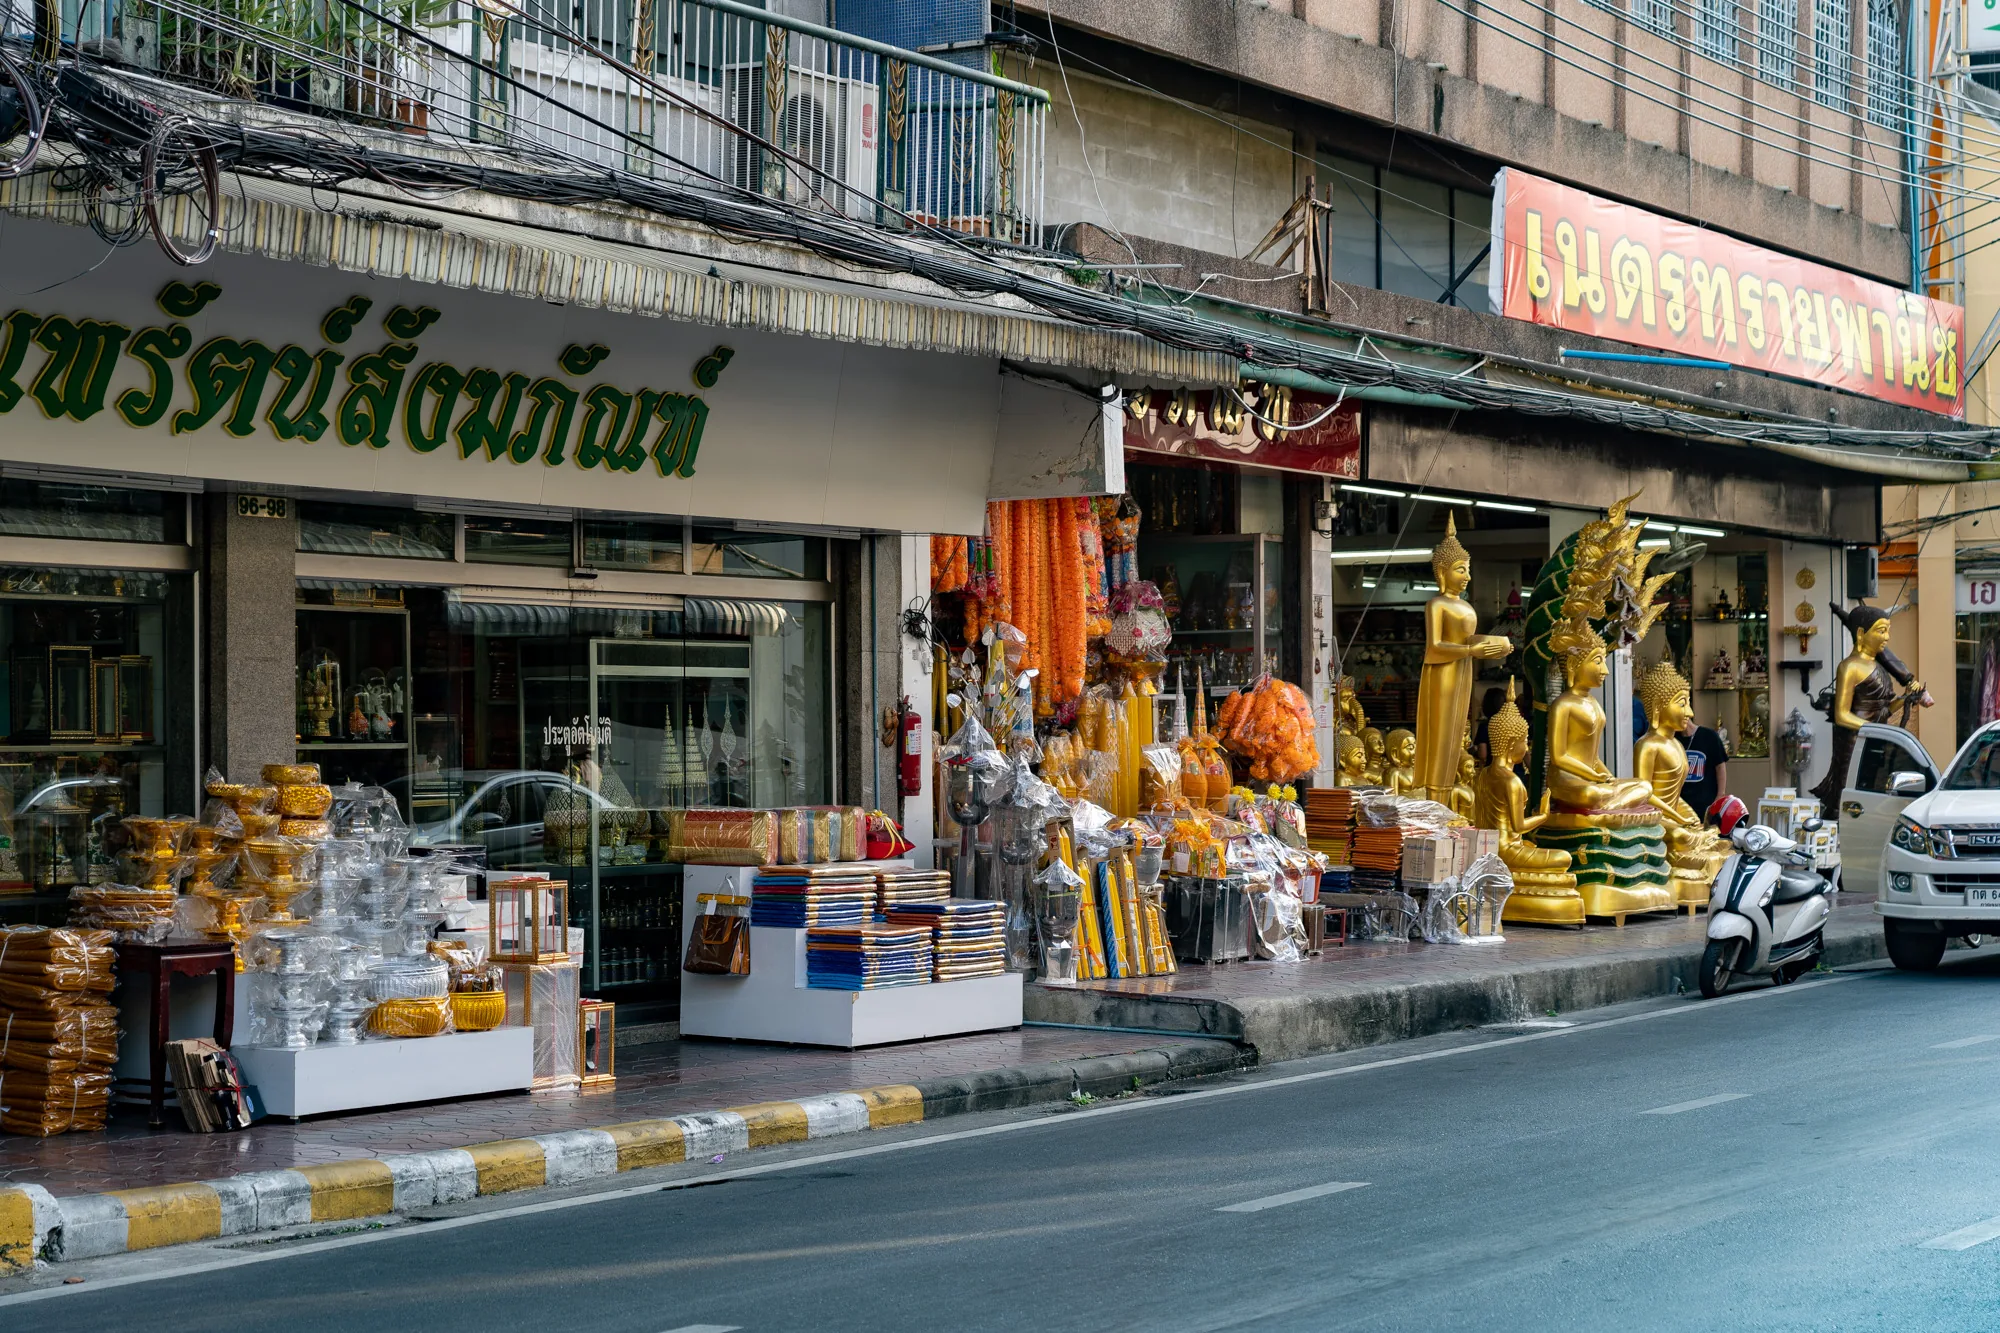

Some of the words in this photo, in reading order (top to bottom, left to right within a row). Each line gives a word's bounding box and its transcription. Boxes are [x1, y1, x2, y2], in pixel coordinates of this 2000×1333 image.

[238, 496, 286, 517] 96-98
[1971, 835, 2000, 845] ISU
[1972, 889, 1987, 900] กต
[1991, 889, 2000, 900] 6
